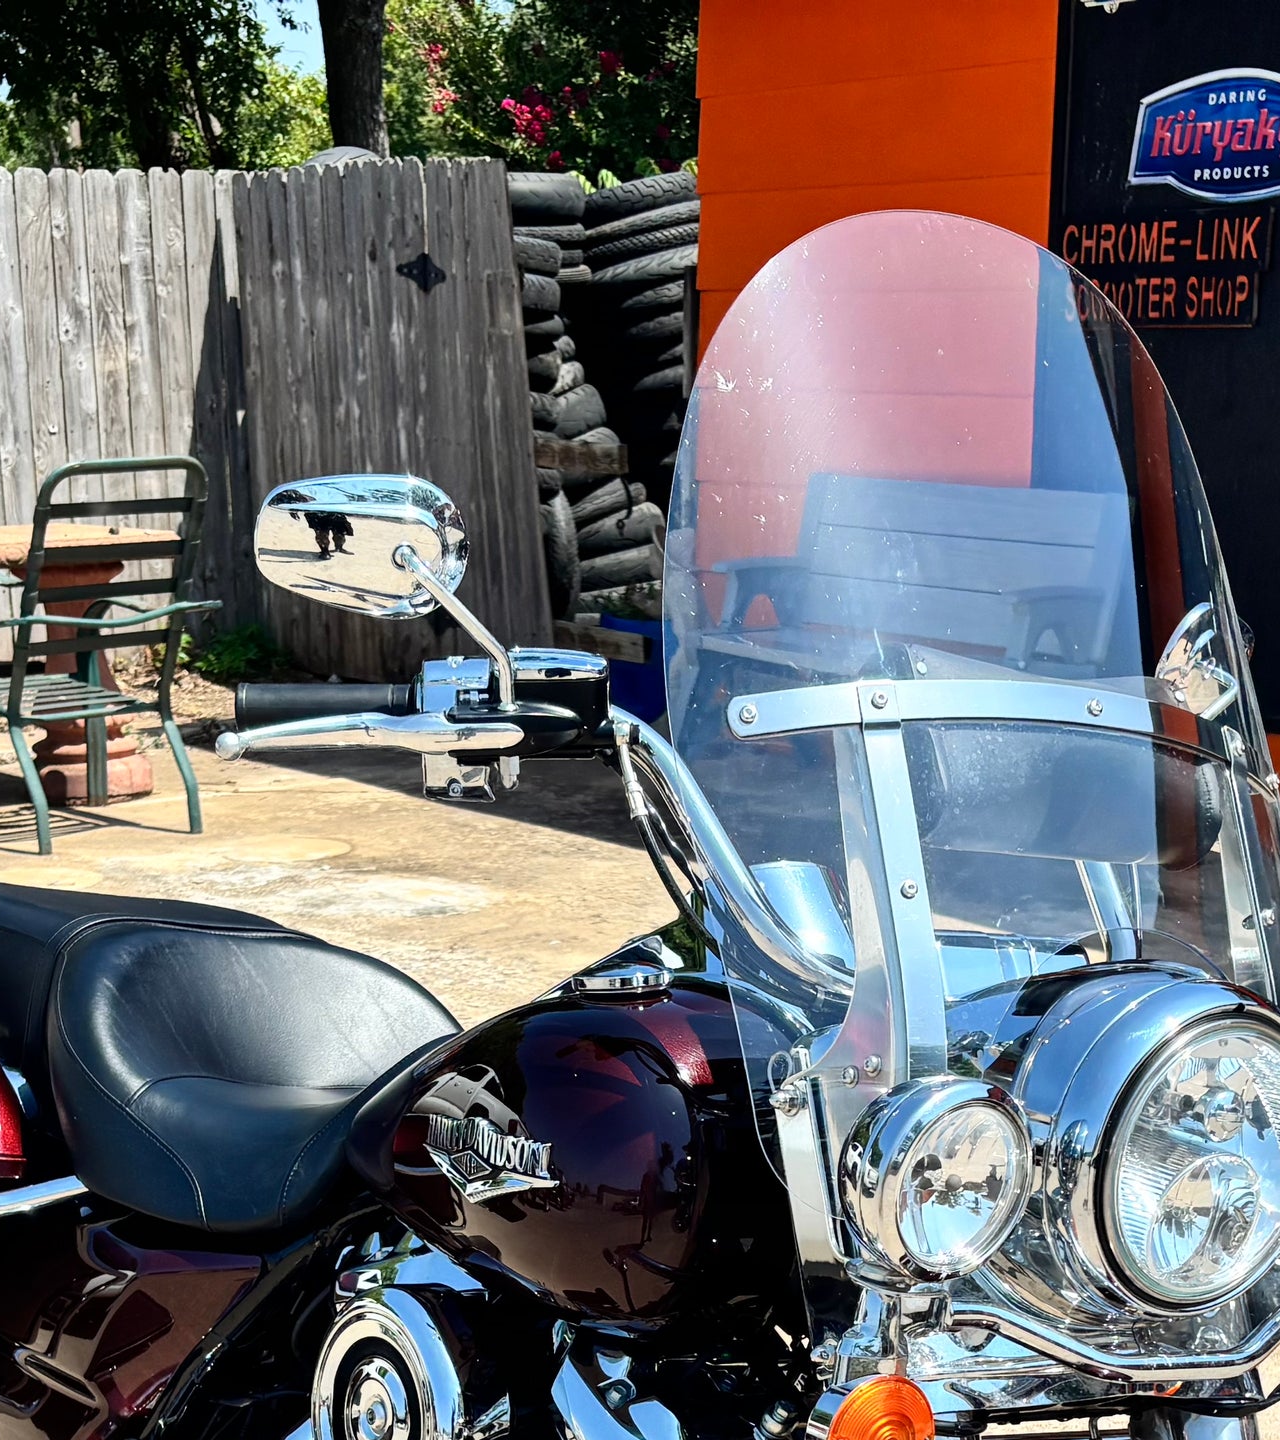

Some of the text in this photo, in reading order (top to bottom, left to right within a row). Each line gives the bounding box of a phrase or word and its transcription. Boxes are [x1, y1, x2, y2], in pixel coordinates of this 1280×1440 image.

[1208, 89, 1267, 105] DARING
[1194, 165, 1270, 181] PRODUCTS
[1062, 216, 1262, 265] CHROME-LINK
[1185, 275, 1249, 319] SHOP
